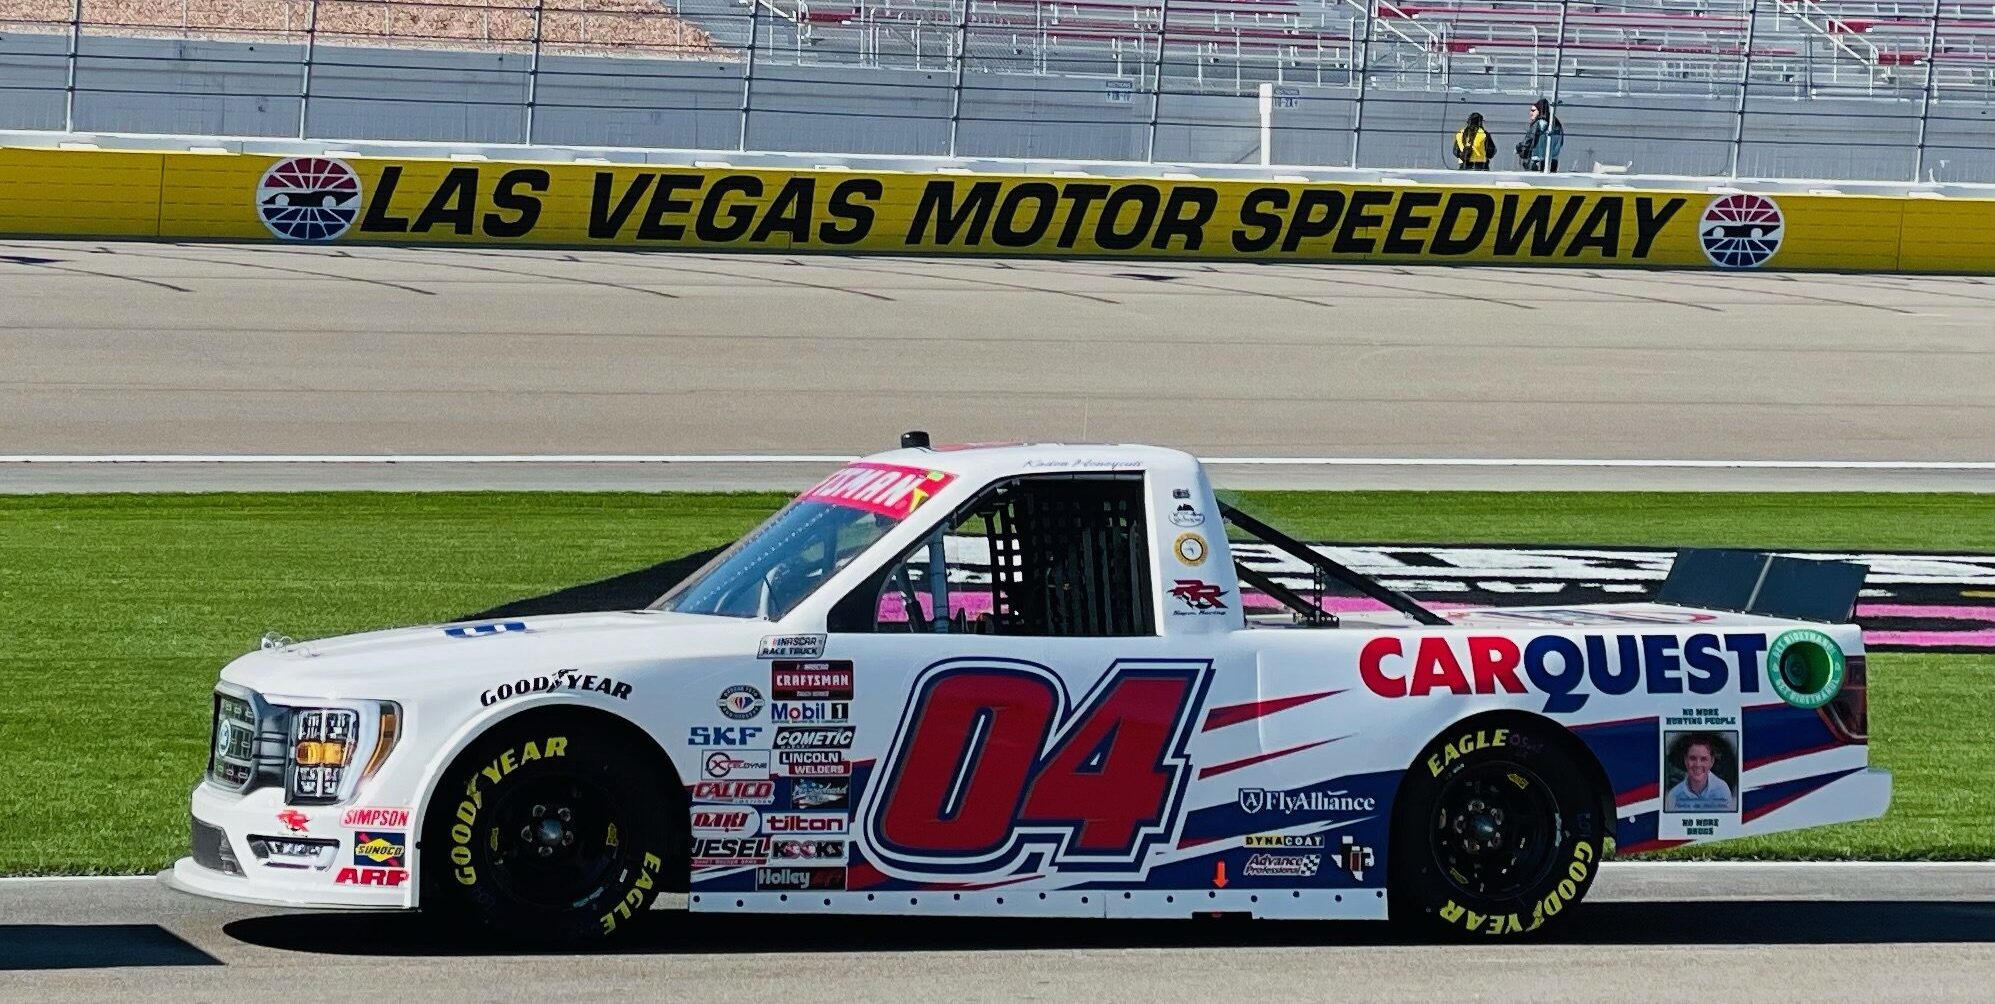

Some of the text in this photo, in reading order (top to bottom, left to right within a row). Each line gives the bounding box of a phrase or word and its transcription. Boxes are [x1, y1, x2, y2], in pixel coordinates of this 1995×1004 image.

[361, 167, 1687, 259] LAS VEGAS MOTOR SPEEDWAY
[780, 637, 817, 645] NASCAR
[776, 675, 849, 686] CRAFTSMAN
[1359, 633, 1767, 713] CARQUEST
[480, 668, 633, 707] GOODYEAR
[771, 702, 825, 719] Mobil
[836, 704, 843, 719] 1
[687, 727, 763, 745] SKF
[776, 729, 853, 745] COMETIC
[782, 752, 839, 763] LINCOLN
[1427, 729, 1510, 777] EAGLE
[794, 765, 844, 774] WELDERS
[873, 667, 1200, 860] 04
[695, 782, 773, 798] CALICO
[451, 736, 568, 886] GOODYEAR
[1266, 790, 1375, 814] FlyAlliance
[345, 809, 409, 827] SIMPSON
[692, 812, 749, 827] DART
[767, 816, 843, 830] tilton
[1696, 819, 1719, 827] MORE
[359, 845, 402, 856] SUNOCO
[690, 838, 770, 858] JESEL
[772, 840, 844, 859] KOOKS
[1246, 836, 1322, 847] DYNACOAT
[1249, 853, 1303, 866] Advance
[336, 868, 410, 886] ARP
[758, 869, 810, 889] Holley
[1247, 866, 1299, 875] Professional
[600, 851, 661, 935] EAGLE
[1439, 841, 1593, 935] GOODYEAR
